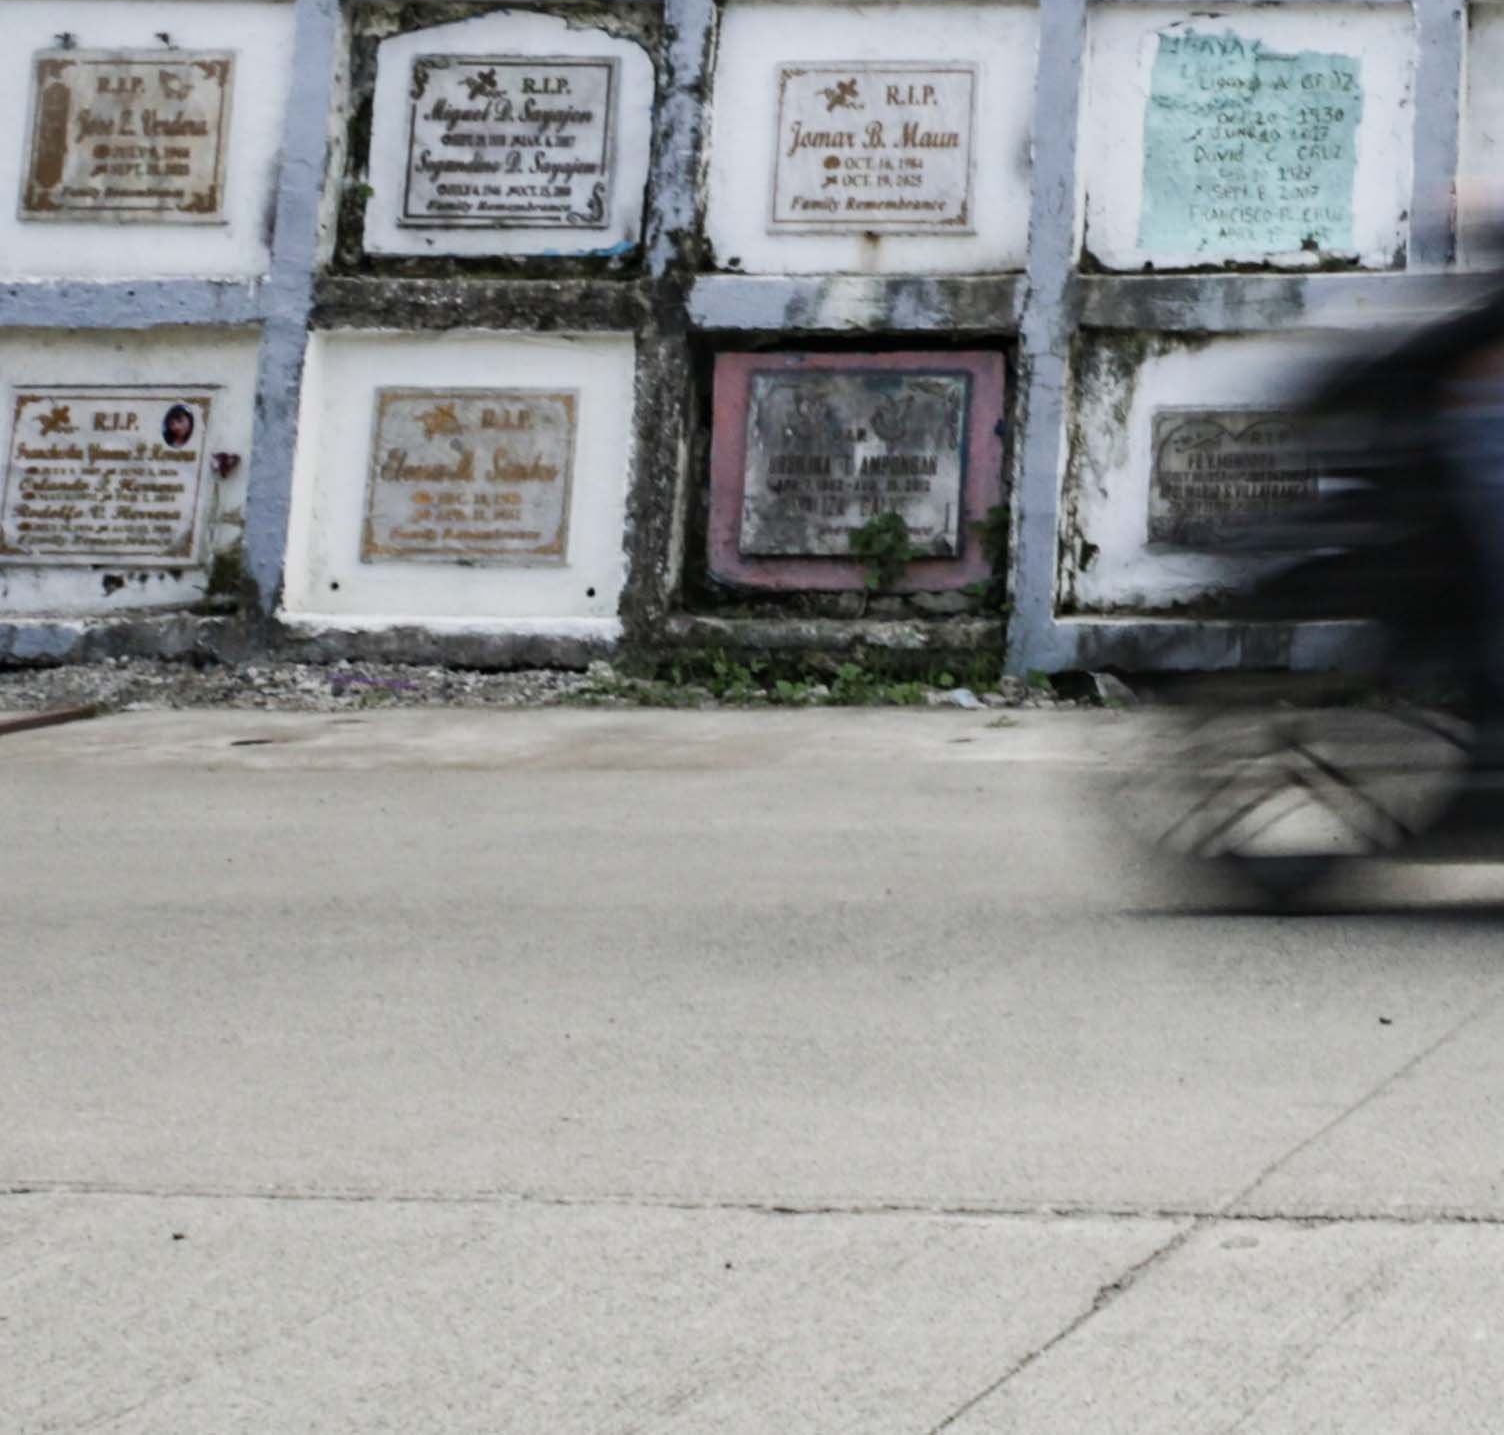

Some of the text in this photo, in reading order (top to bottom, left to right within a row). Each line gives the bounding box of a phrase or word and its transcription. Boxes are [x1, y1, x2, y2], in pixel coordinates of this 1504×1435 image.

[97, 77, 146, 94] R.I.P.
[521, 77, 572, 95] R.I.P.
[885, 84, 939, 106] R.I.P.
[787, 119, 961, 158] Jomar B. Maun
[791, 196, 948, 214] Family Remembrance
[93, 412, 140, 431] R.I.P.
